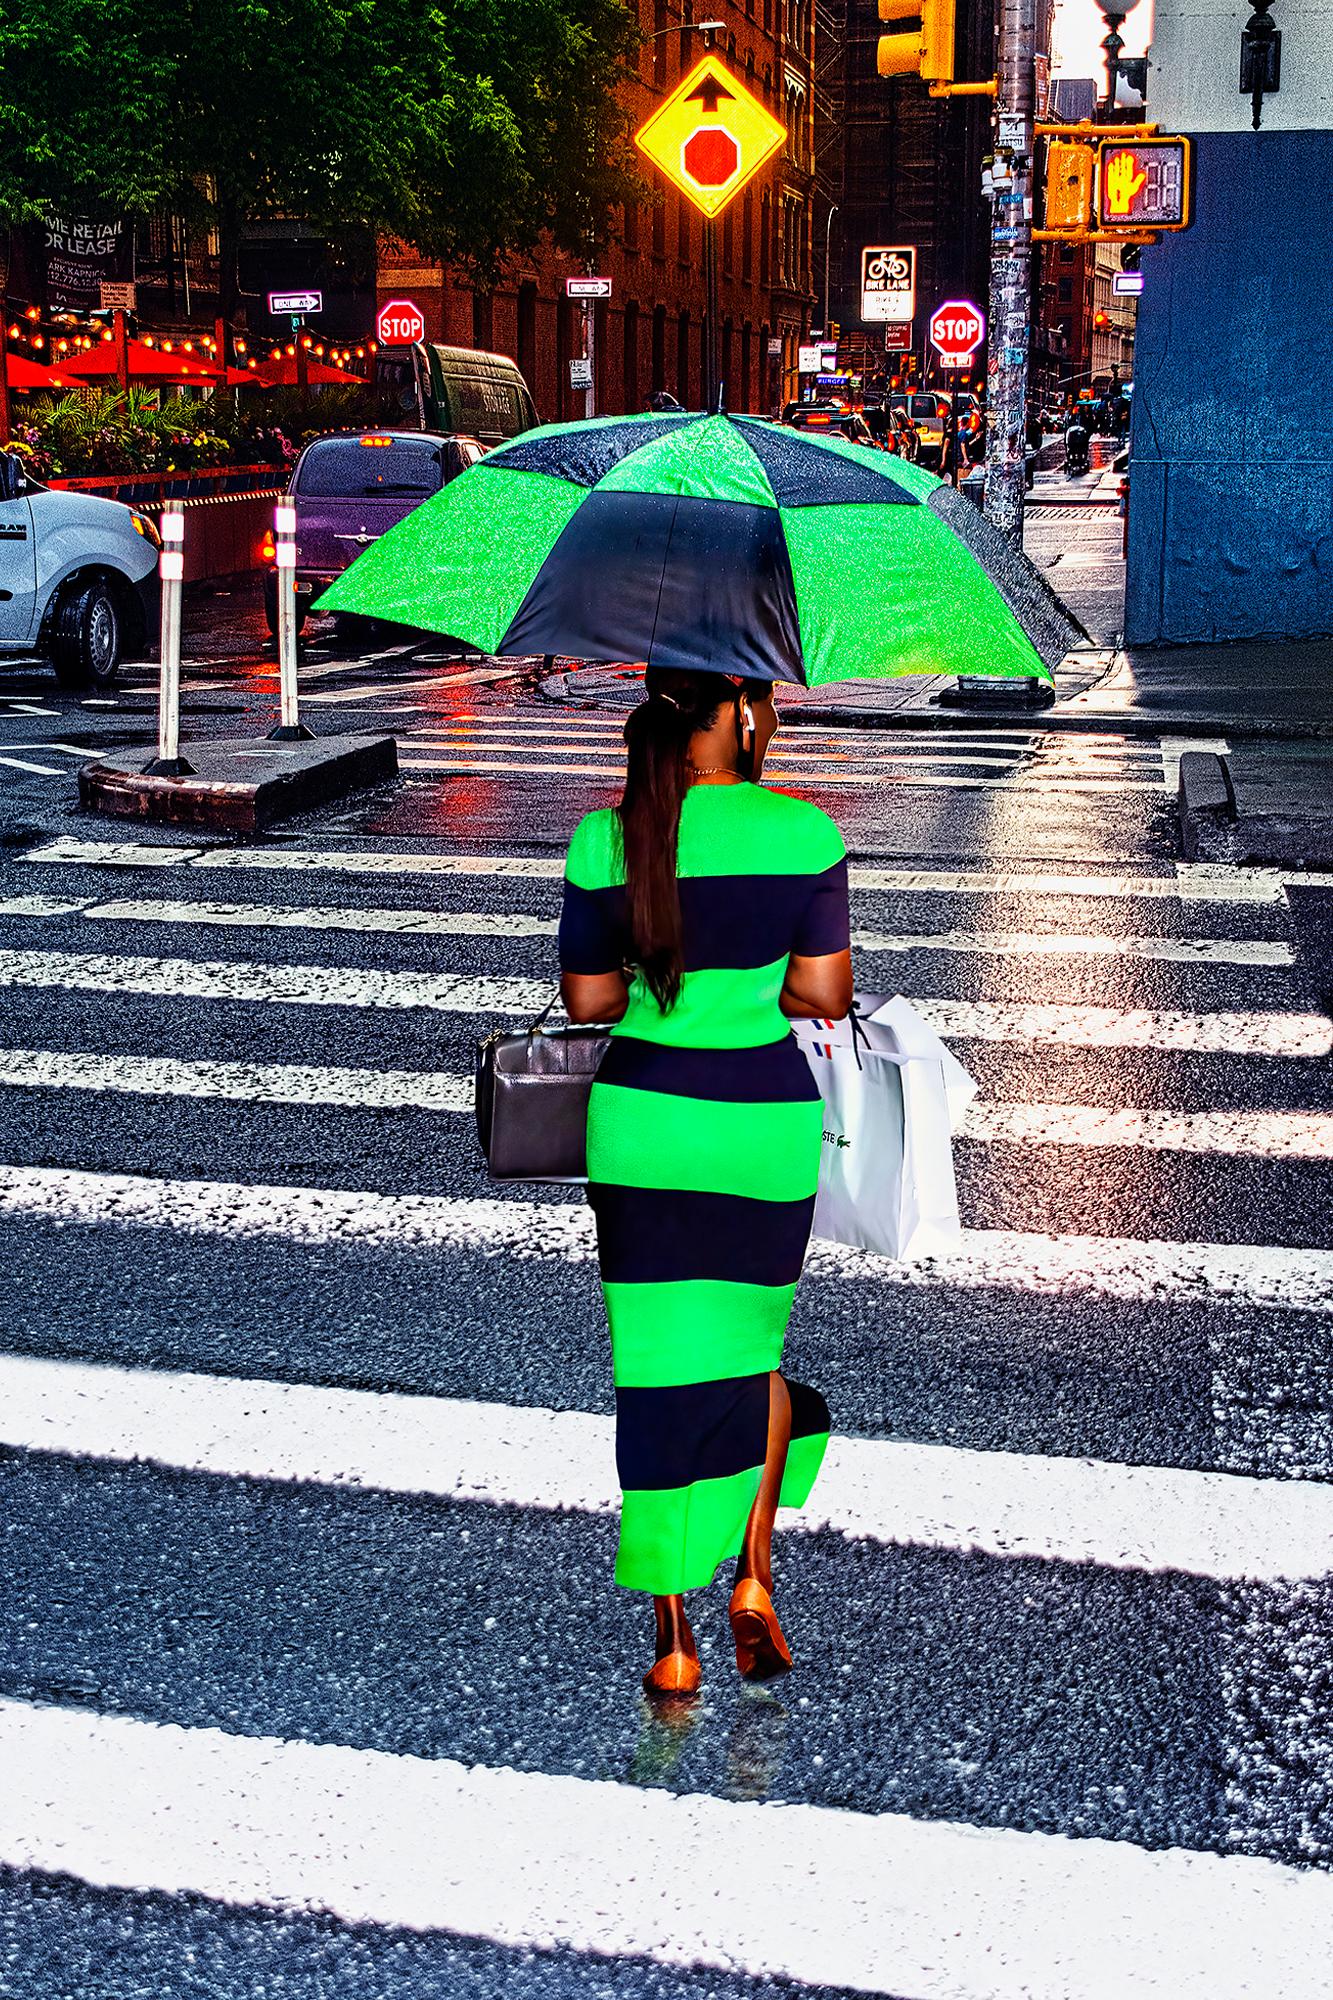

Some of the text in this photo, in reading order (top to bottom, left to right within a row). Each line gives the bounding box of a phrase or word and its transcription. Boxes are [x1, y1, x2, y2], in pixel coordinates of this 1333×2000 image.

[73, 220, 123, 239] RETAIL
[67, 238, 116, 255] LEASE
[866, 279, 910, 290] BIKE LANE
[381, 318, 421, 338] STOP
[933, 319, 979, 340] STOP
[822, 1130, 835, 1144] STE
